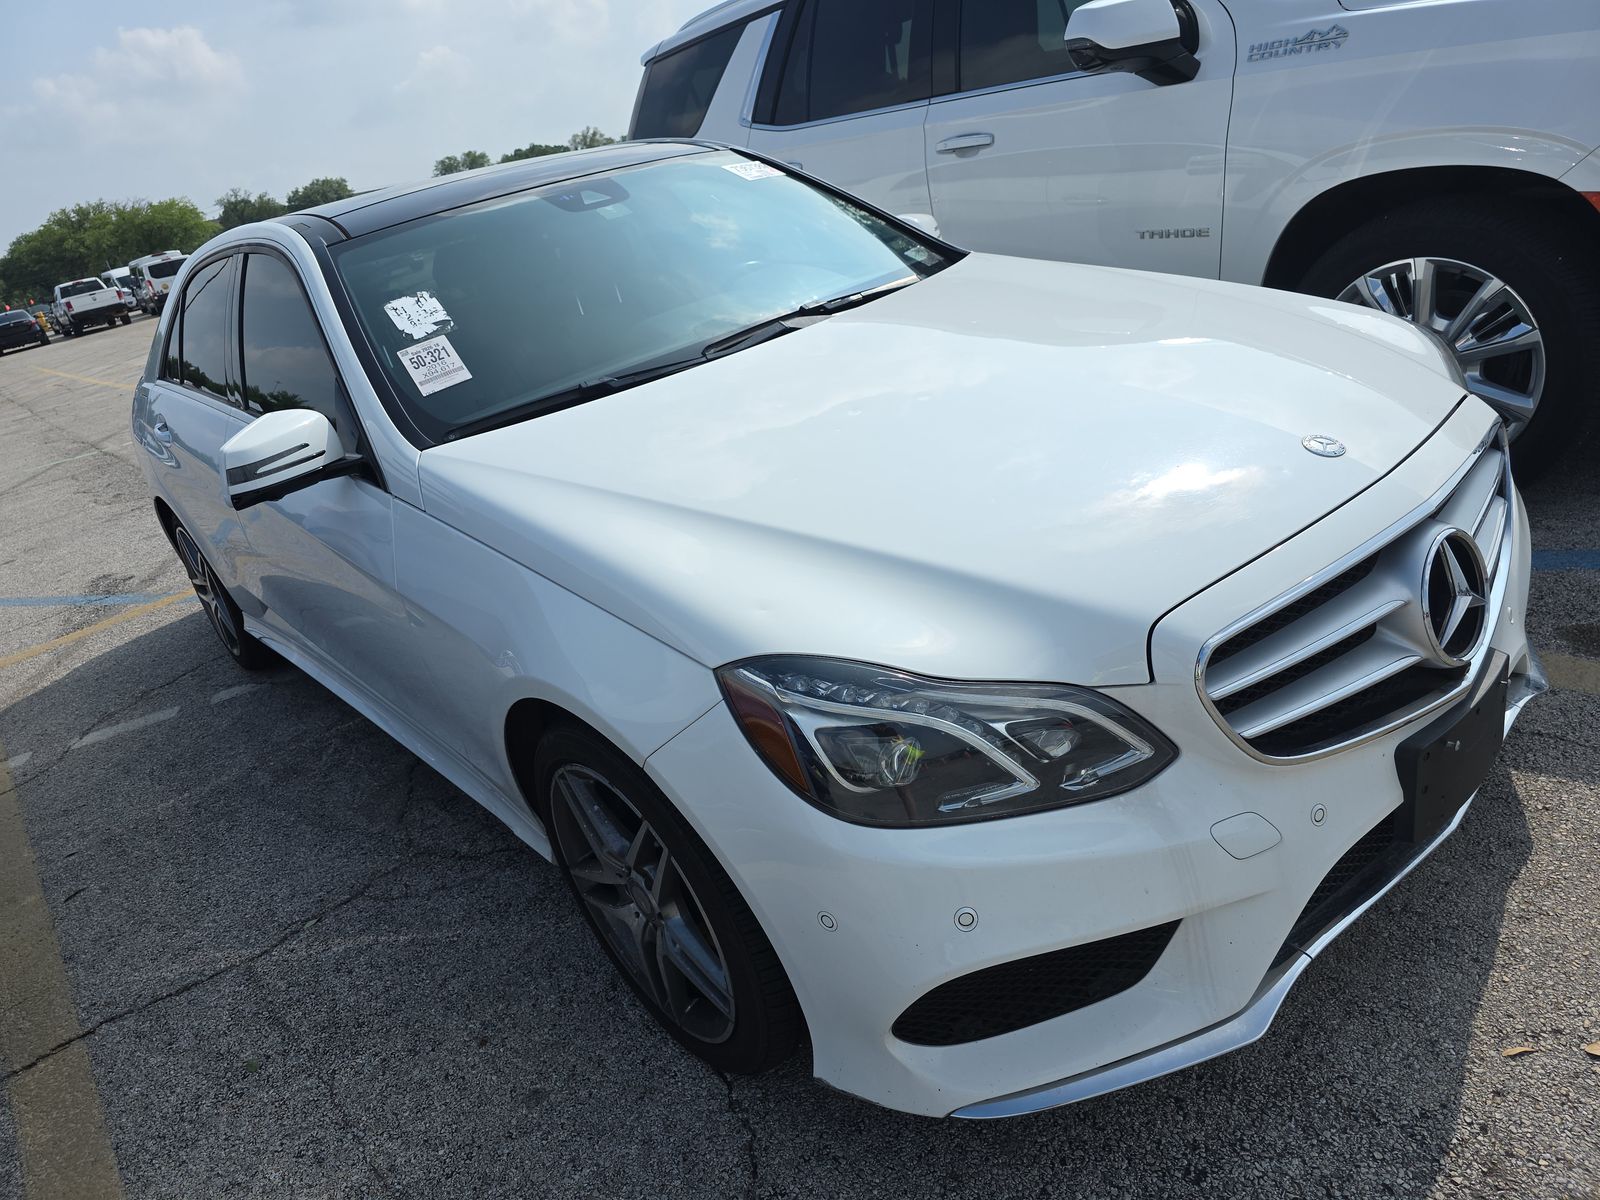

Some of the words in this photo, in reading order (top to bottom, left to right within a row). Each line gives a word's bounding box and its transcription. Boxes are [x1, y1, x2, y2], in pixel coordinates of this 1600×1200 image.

[1247, 41, 1341, 62] COUNTRY
[1249, 37, 1298, 53] HIGH
[1136, 228, 1210, 239] TAHOE
[409, 346, 451, 370] 50:321
[426, 360, 447, 372] 2016
